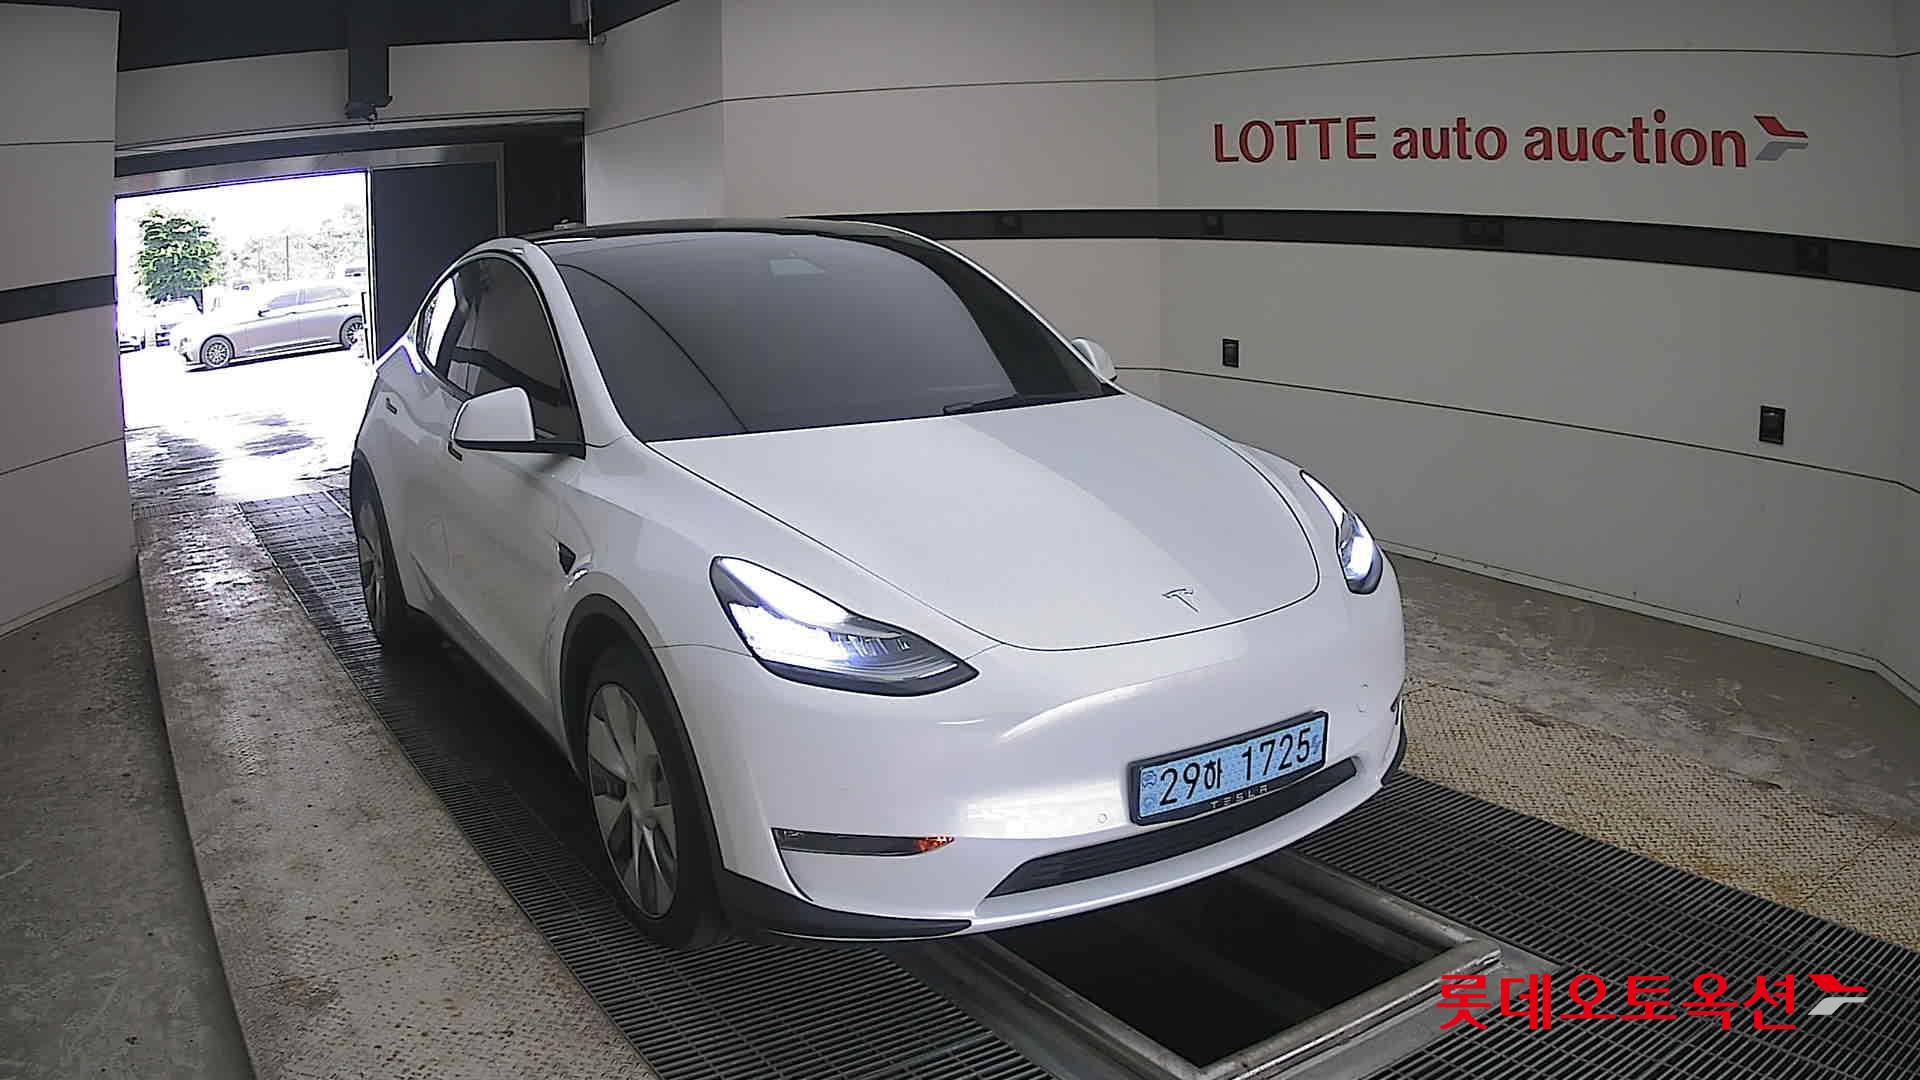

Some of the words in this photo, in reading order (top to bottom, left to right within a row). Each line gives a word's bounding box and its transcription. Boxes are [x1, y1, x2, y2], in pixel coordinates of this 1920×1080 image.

[1214, 116, 1377, 163] LOTTE
[1392, 117, 1508, 161] auto
[1523, 109, 1747, 168] auction
[1159, 757, 1223, 806] 29하
[1241, 727, 1311, 781] 1725
[1210, 784, 1269, 809] TESLA
